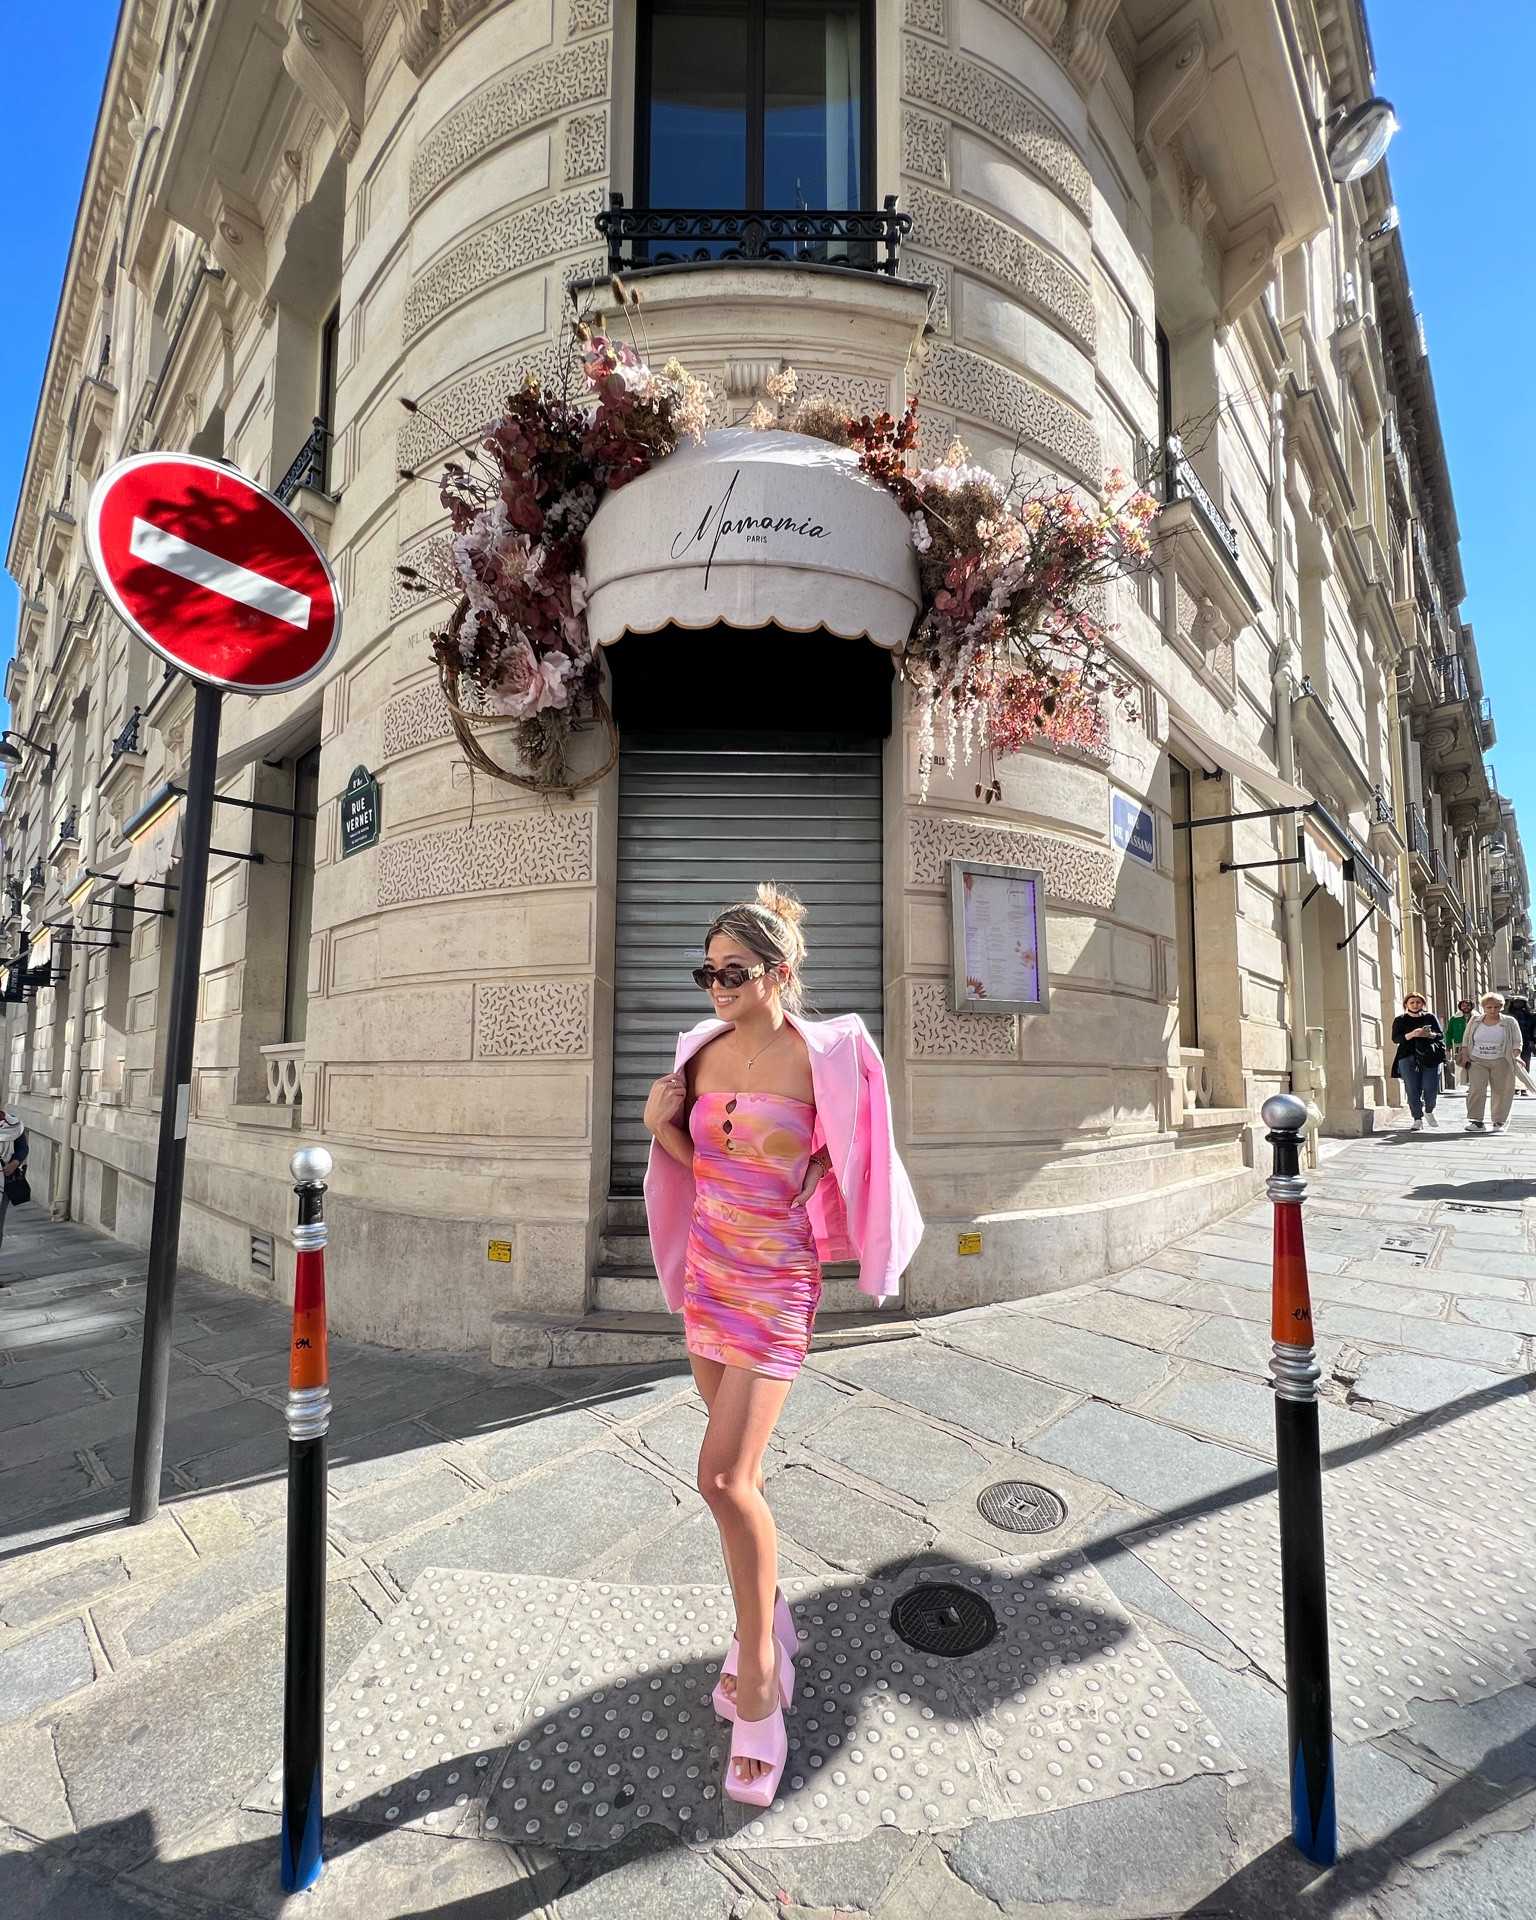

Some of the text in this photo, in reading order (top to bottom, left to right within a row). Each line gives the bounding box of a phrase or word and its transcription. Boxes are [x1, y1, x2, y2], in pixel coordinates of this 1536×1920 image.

[671, 469, 832, 591] Mamamia
[746, 535, 768, 544] PARIS
[351, 798, 366, 815] RUE
[346, 809, 373, 832] VERNET
[1114, 824, 1124, 840] DE
